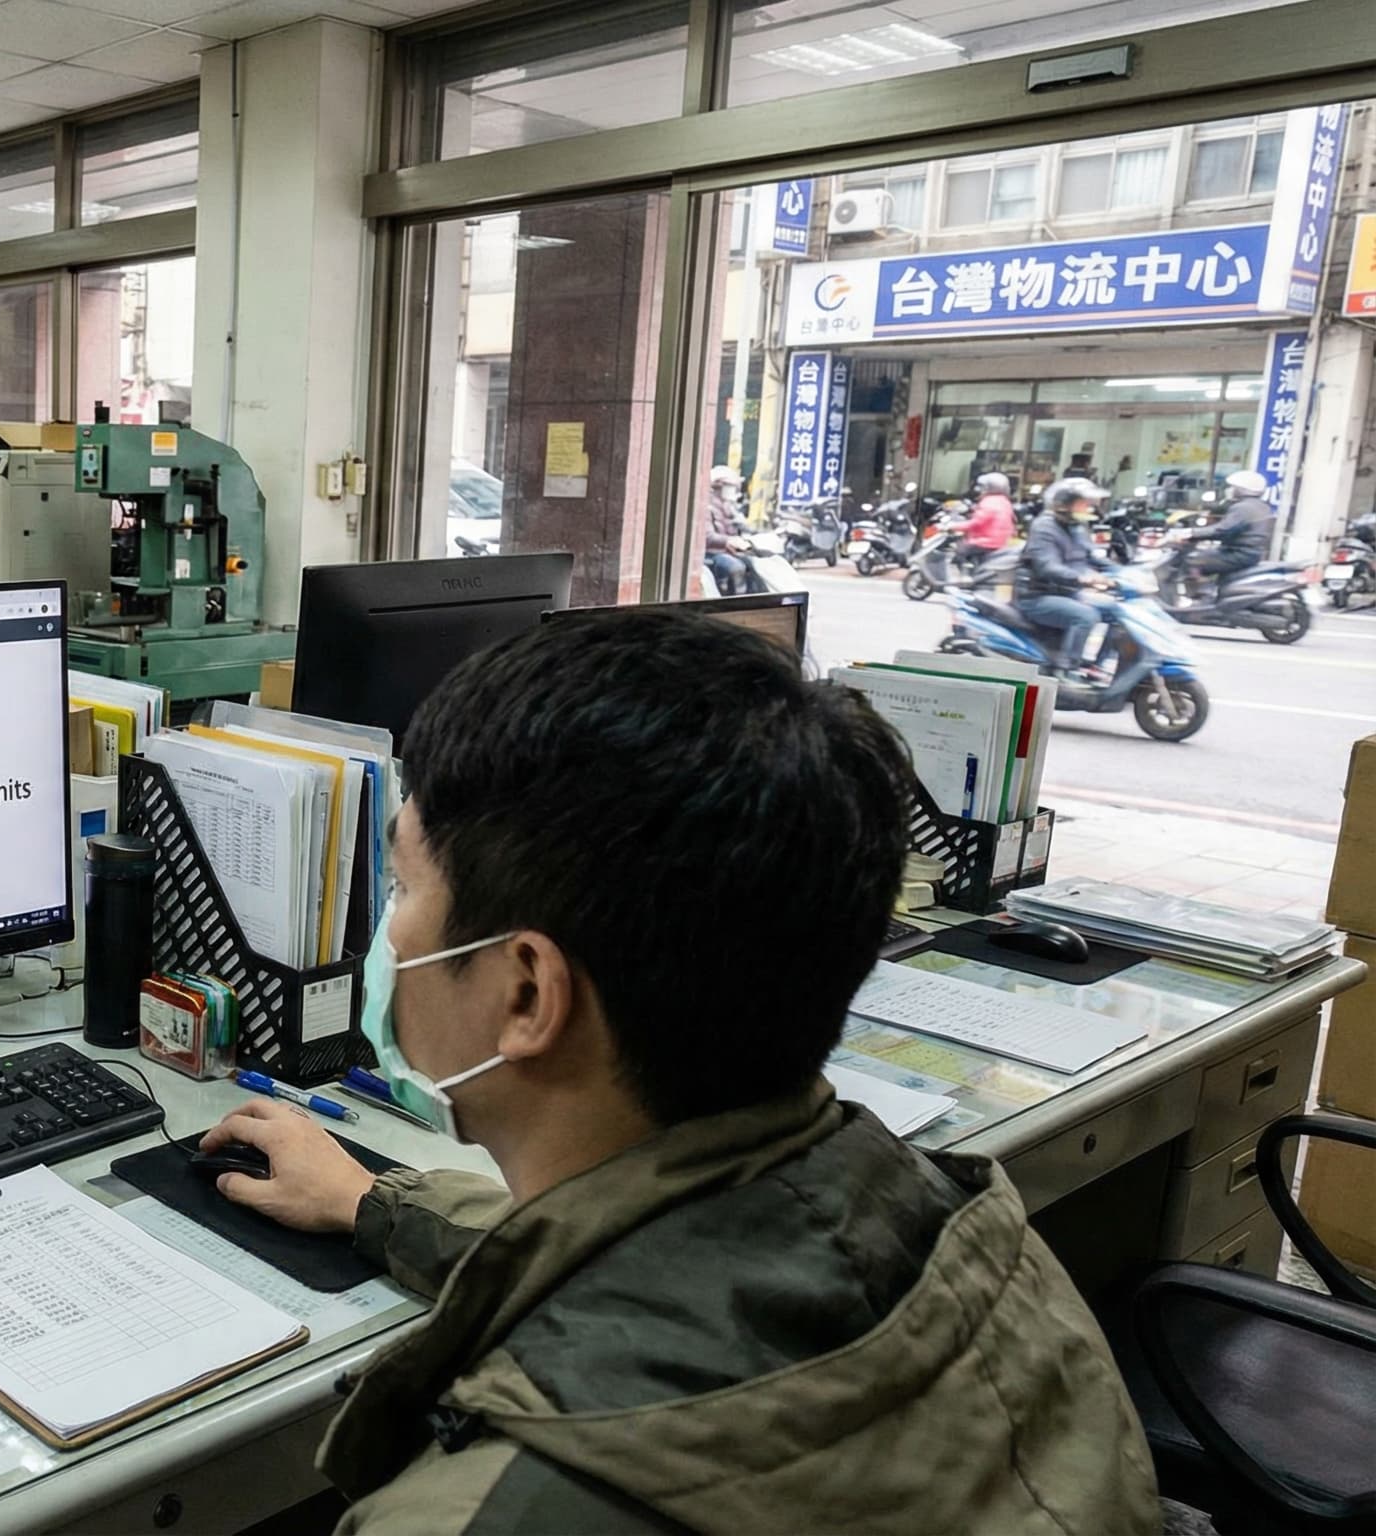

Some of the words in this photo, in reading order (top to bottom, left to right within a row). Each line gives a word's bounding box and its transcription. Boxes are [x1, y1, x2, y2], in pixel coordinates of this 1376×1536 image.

[781, 181, 805, 216] 心
[892, 241, 1252, 318] 台灣物流中心
[787, 359, 820, 499] 台灣物流中心
